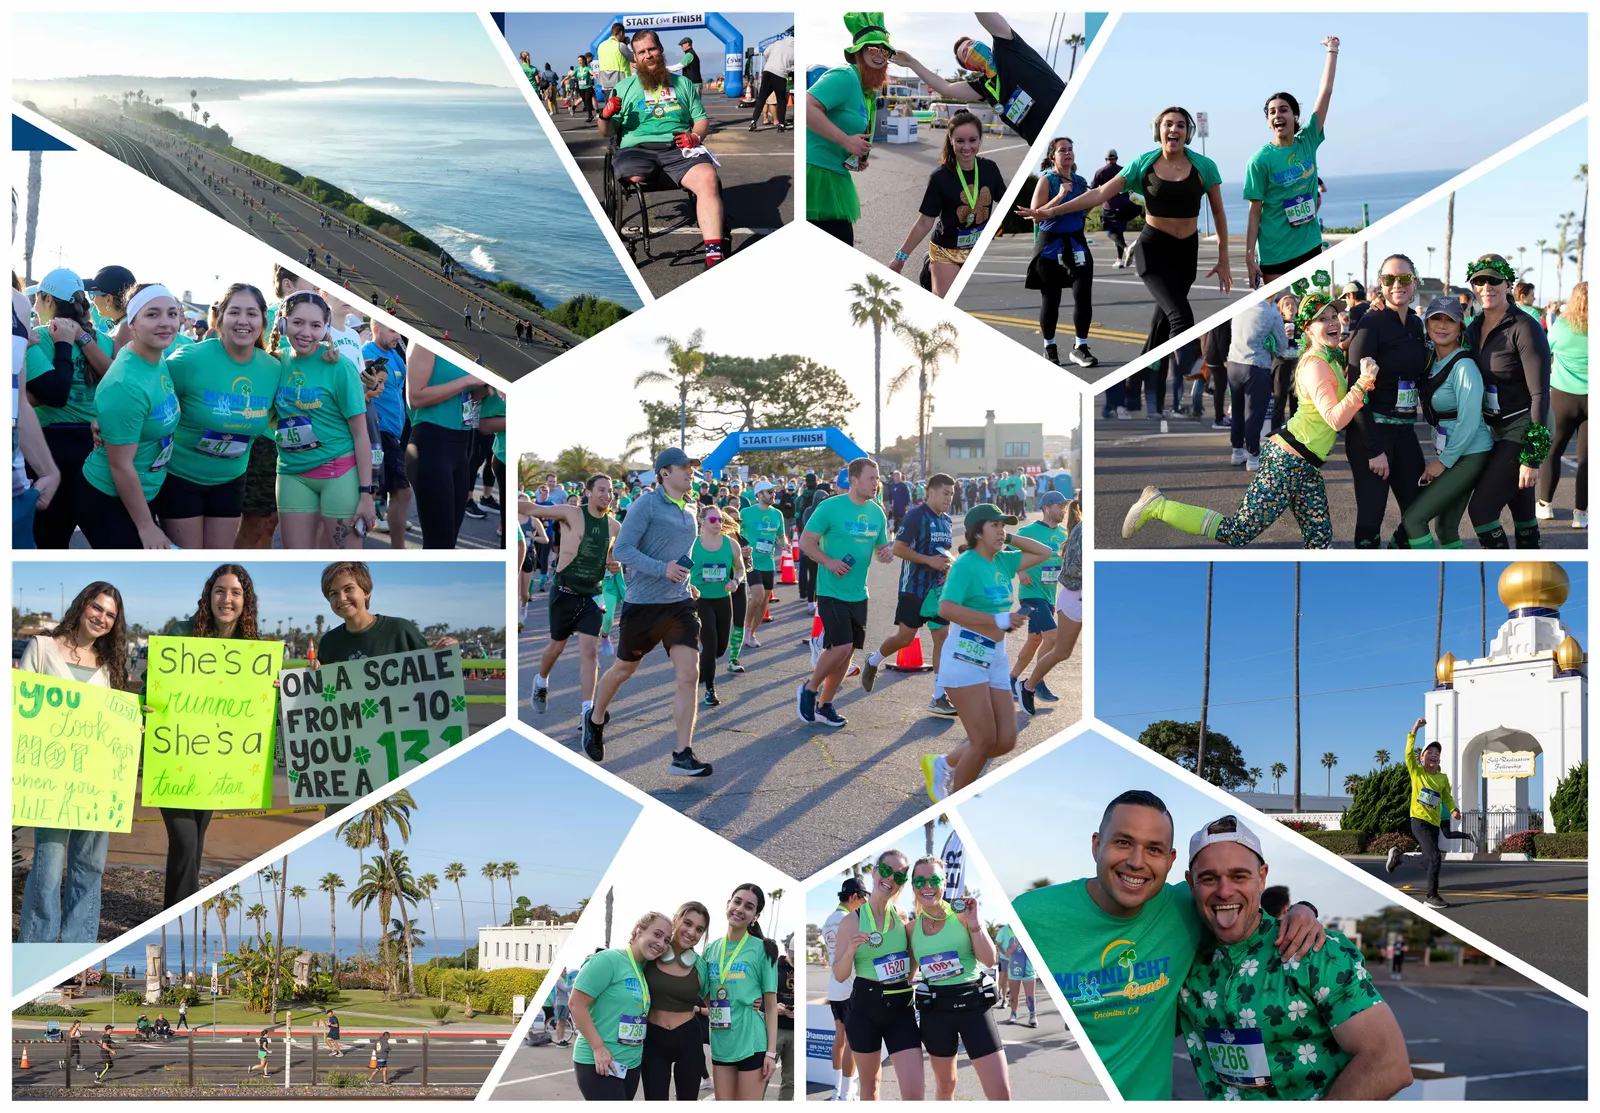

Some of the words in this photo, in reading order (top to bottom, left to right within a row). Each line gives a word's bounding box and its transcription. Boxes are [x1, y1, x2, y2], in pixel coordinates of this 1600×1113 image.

[626, 17, 654, 26] START
[672, 14, 702, 24] FINISH
[1294, 202, 1311, 217] 646
[213, 440, 232, 453] 47
[286, 427, 301, 443] 45
[742, 435, 772, 445] START
[792, 433, 823, 443] FINISH
[158, 642, 241, 675] She's
[251, 653, 272, 676] a
[965, 641, 986, 658] 546
[282, 669, 323, 697] ON
[335, 665, 352, 691] A
[363, 649, 455, 691] SCALE
[19, 680, 81, 718] you
[162, 691, 254, 718] runner
[50, 710, 117, 746] Look
[286, 701, 363, 733] FROM
[152, 723, 233, 756] She's
[242, 732, 262, 755] a
[16, 733, 89, 773] HOT
[64, 781, 104, 803] you
[151, 768, 200, 796] track
[208, 772, 245, 796] star
[294, 769, 349, 797] ARE
[355, 768, 374, 797] A
[882, 959, 905, 976] 1520
[1054, 957, 1171, 991] MOONLIGHT
[1123, 972, 1170, 1000] Beach
[710, 1008, 722, 1020] 646
[1093, 1008, 1125, 1019] Encinitas
[1127, 1006, 1139, 1015] CA
[629, 1024, 643, 1037] 736
[806, 1031, 836, 1041] Diamon
[1218, 1045, 1249, 1071] 266
